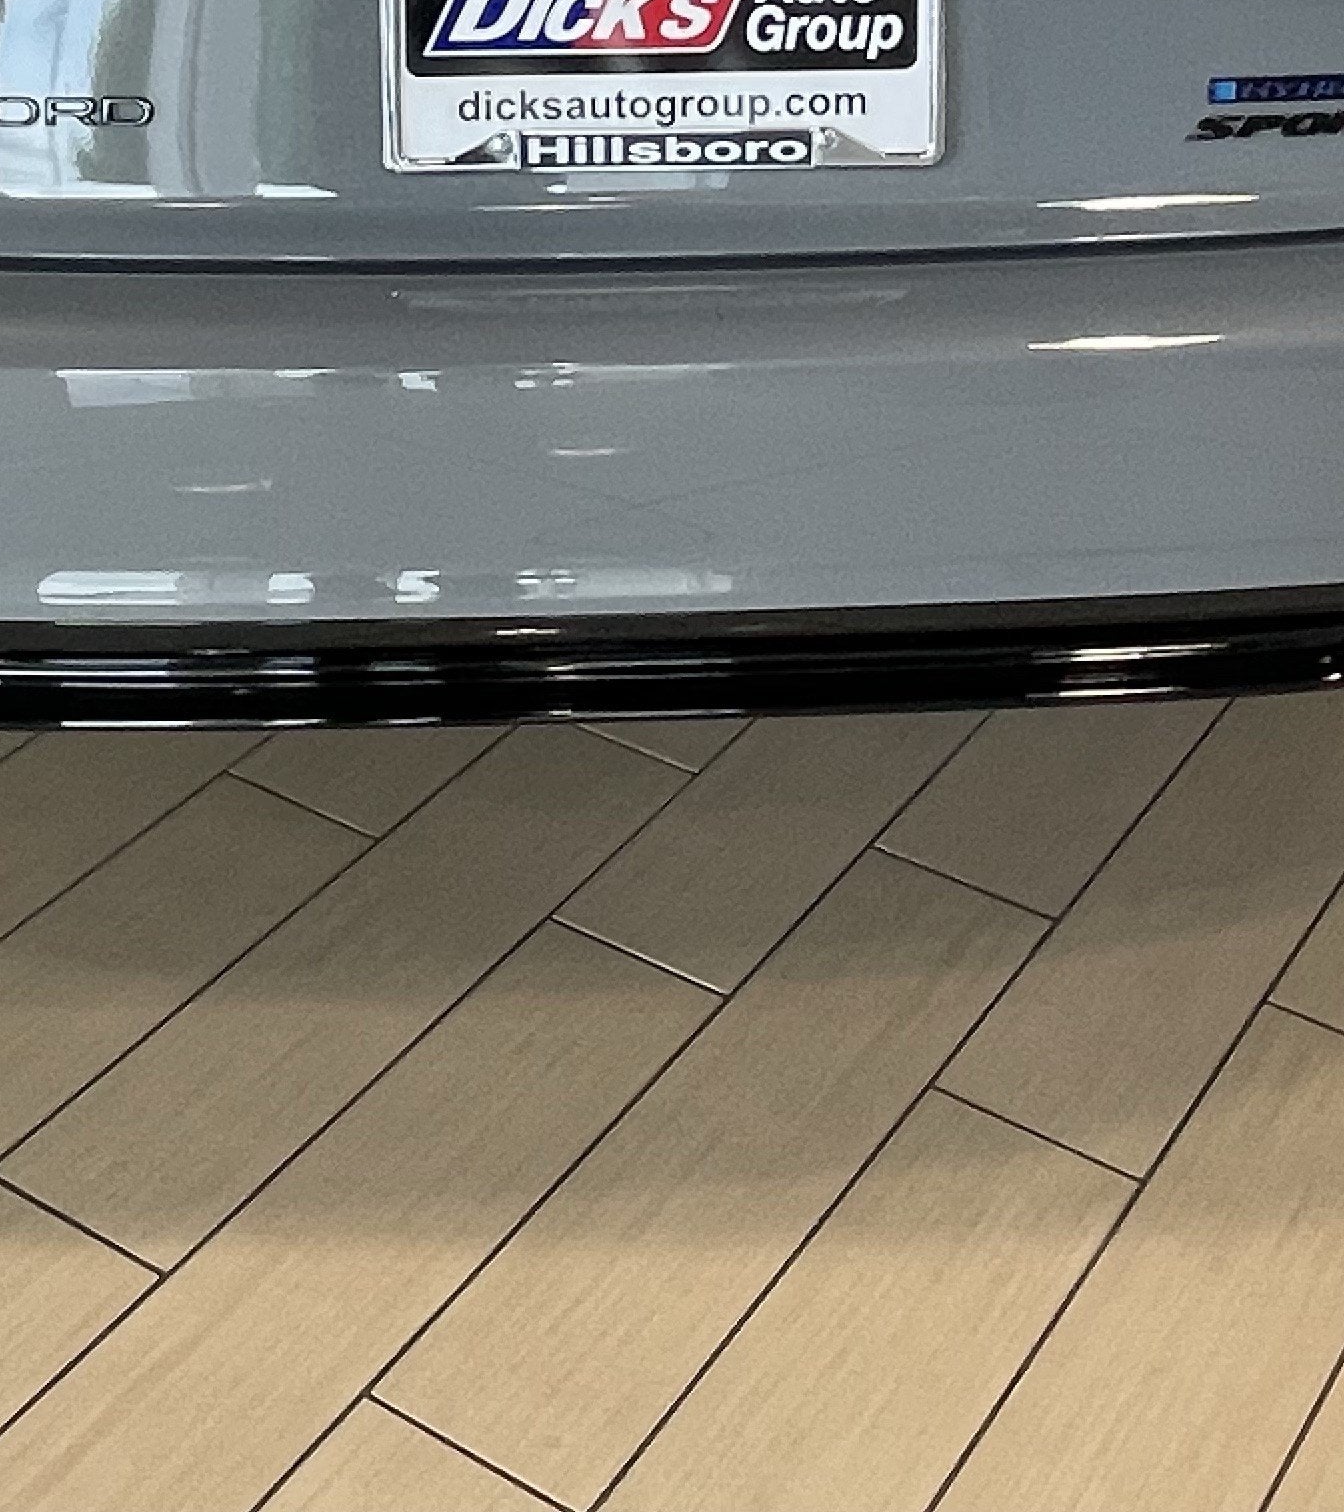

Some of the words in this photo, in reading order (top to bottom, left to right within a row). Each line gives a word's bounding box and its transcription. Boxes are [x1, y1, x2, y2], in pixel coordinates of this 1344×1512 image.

[746, 4, 905, 60] Group
[457, 88, 868, 127] dicksautogroup.com
[526, 135, 809, 165] Hillsboro
